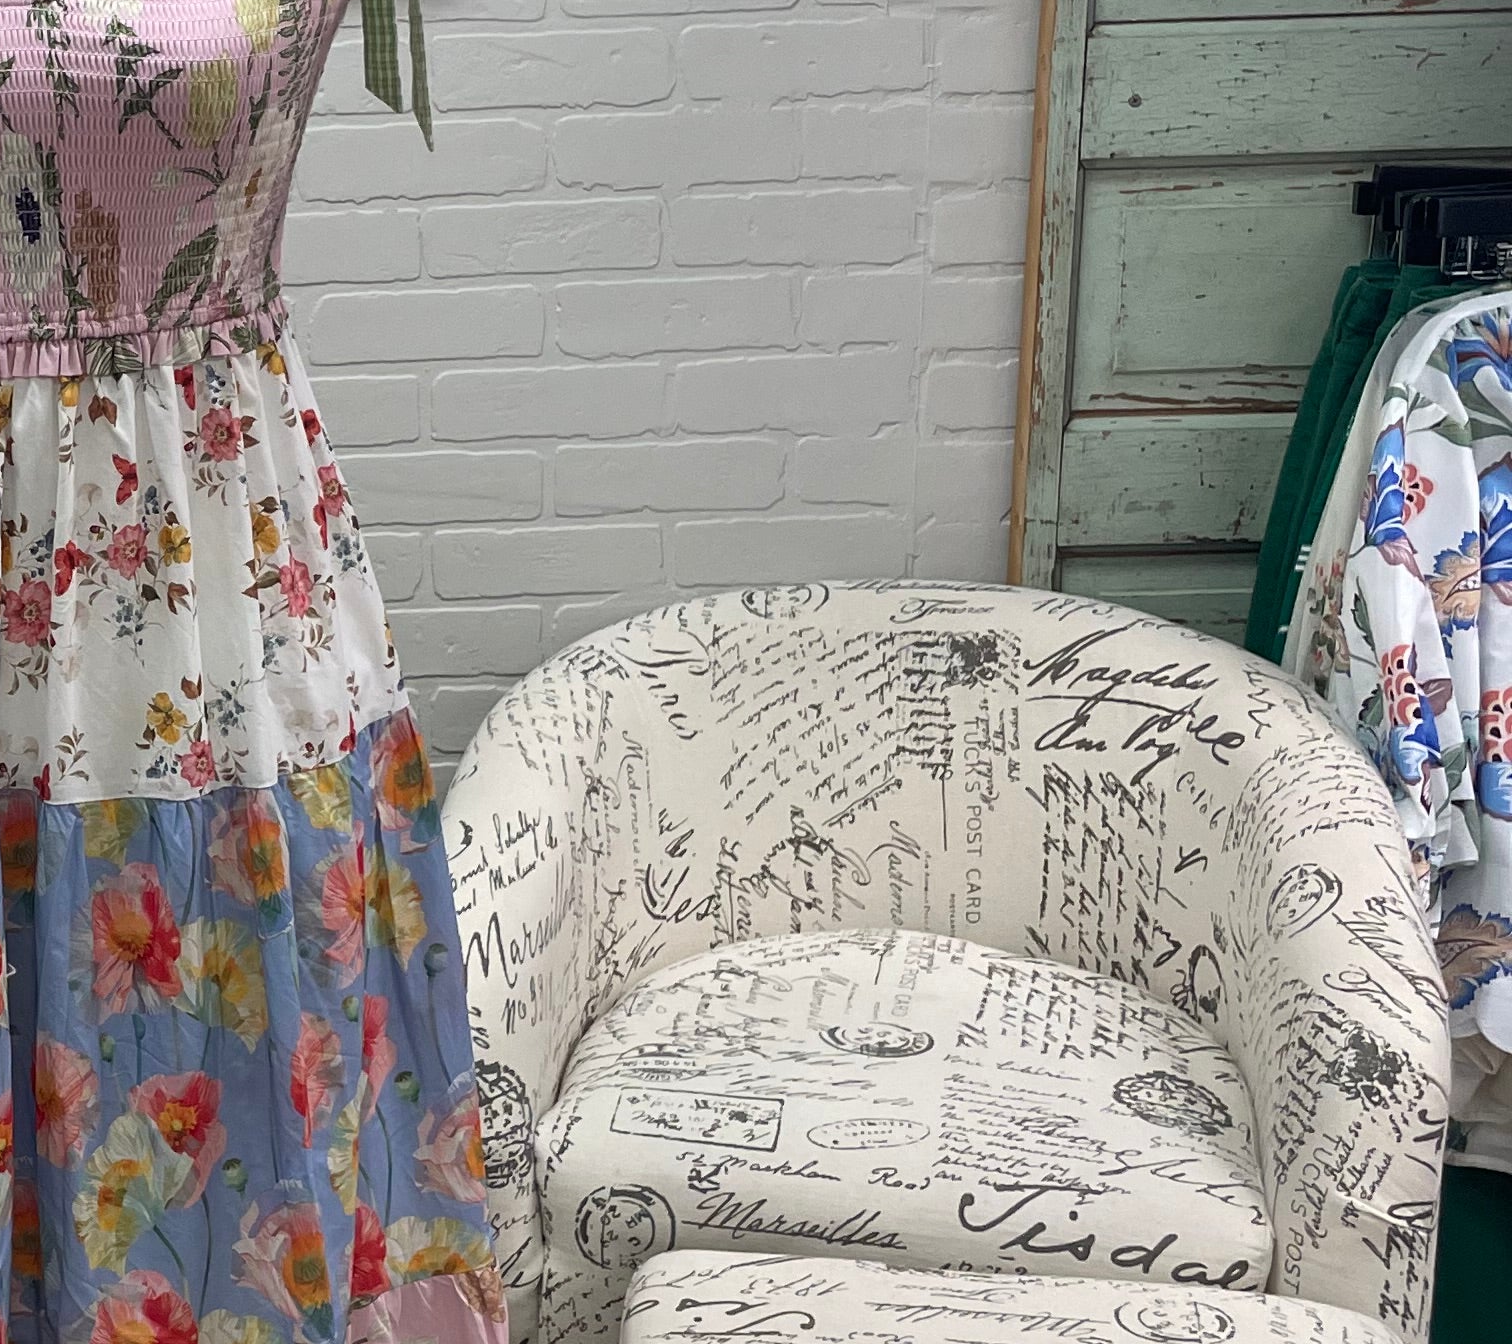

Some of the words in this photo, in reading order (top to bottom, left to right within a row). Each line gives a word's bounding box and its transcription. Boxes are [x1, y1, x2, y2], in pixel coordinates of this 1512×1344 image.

[965, 805, 983, 858] POST
[965, 867, 983, 925] CARD
[1284, 1226, 1305, 1295] POST
